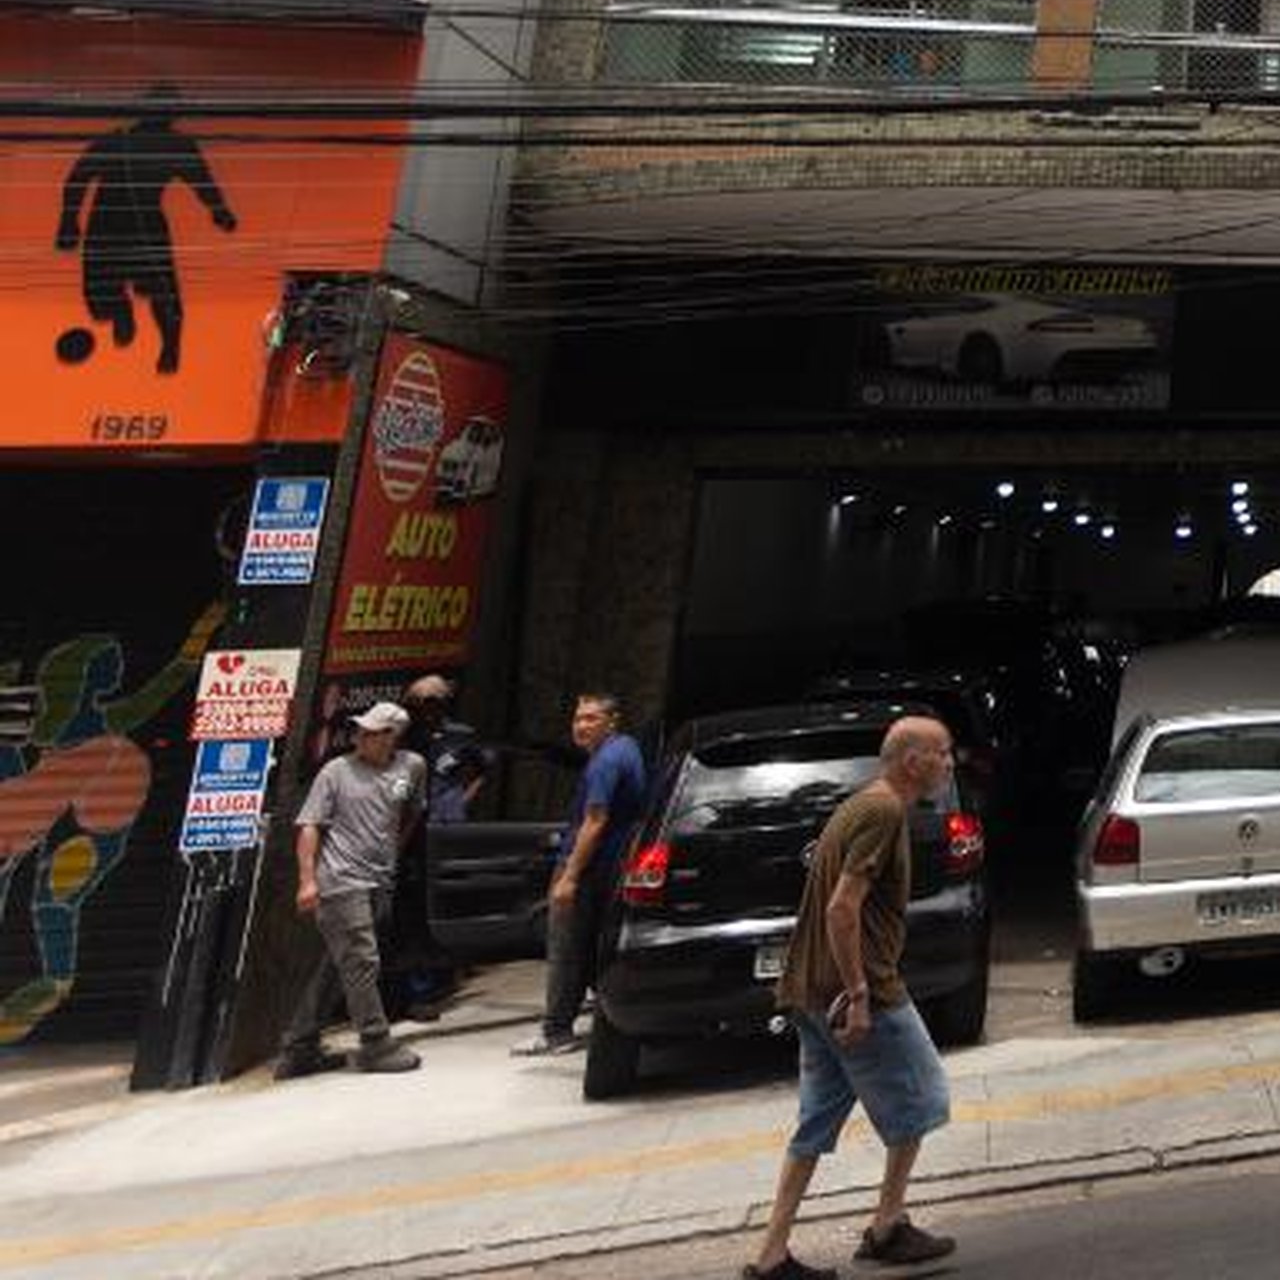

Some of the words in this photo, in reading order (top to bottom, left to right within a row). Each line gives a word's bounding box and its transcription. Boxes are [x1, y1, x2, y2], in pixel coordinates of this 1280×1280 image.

[91, 414, 168, 440] 1969
[250, 532, 315, 549] ALUGA
[385, 510, 458, 559] AUTO
[341, 570, 470, 632] ELÉTRICO
[206, 679, 290, 698] ALUGA
[190, 797, 259, 814] ALUGA
